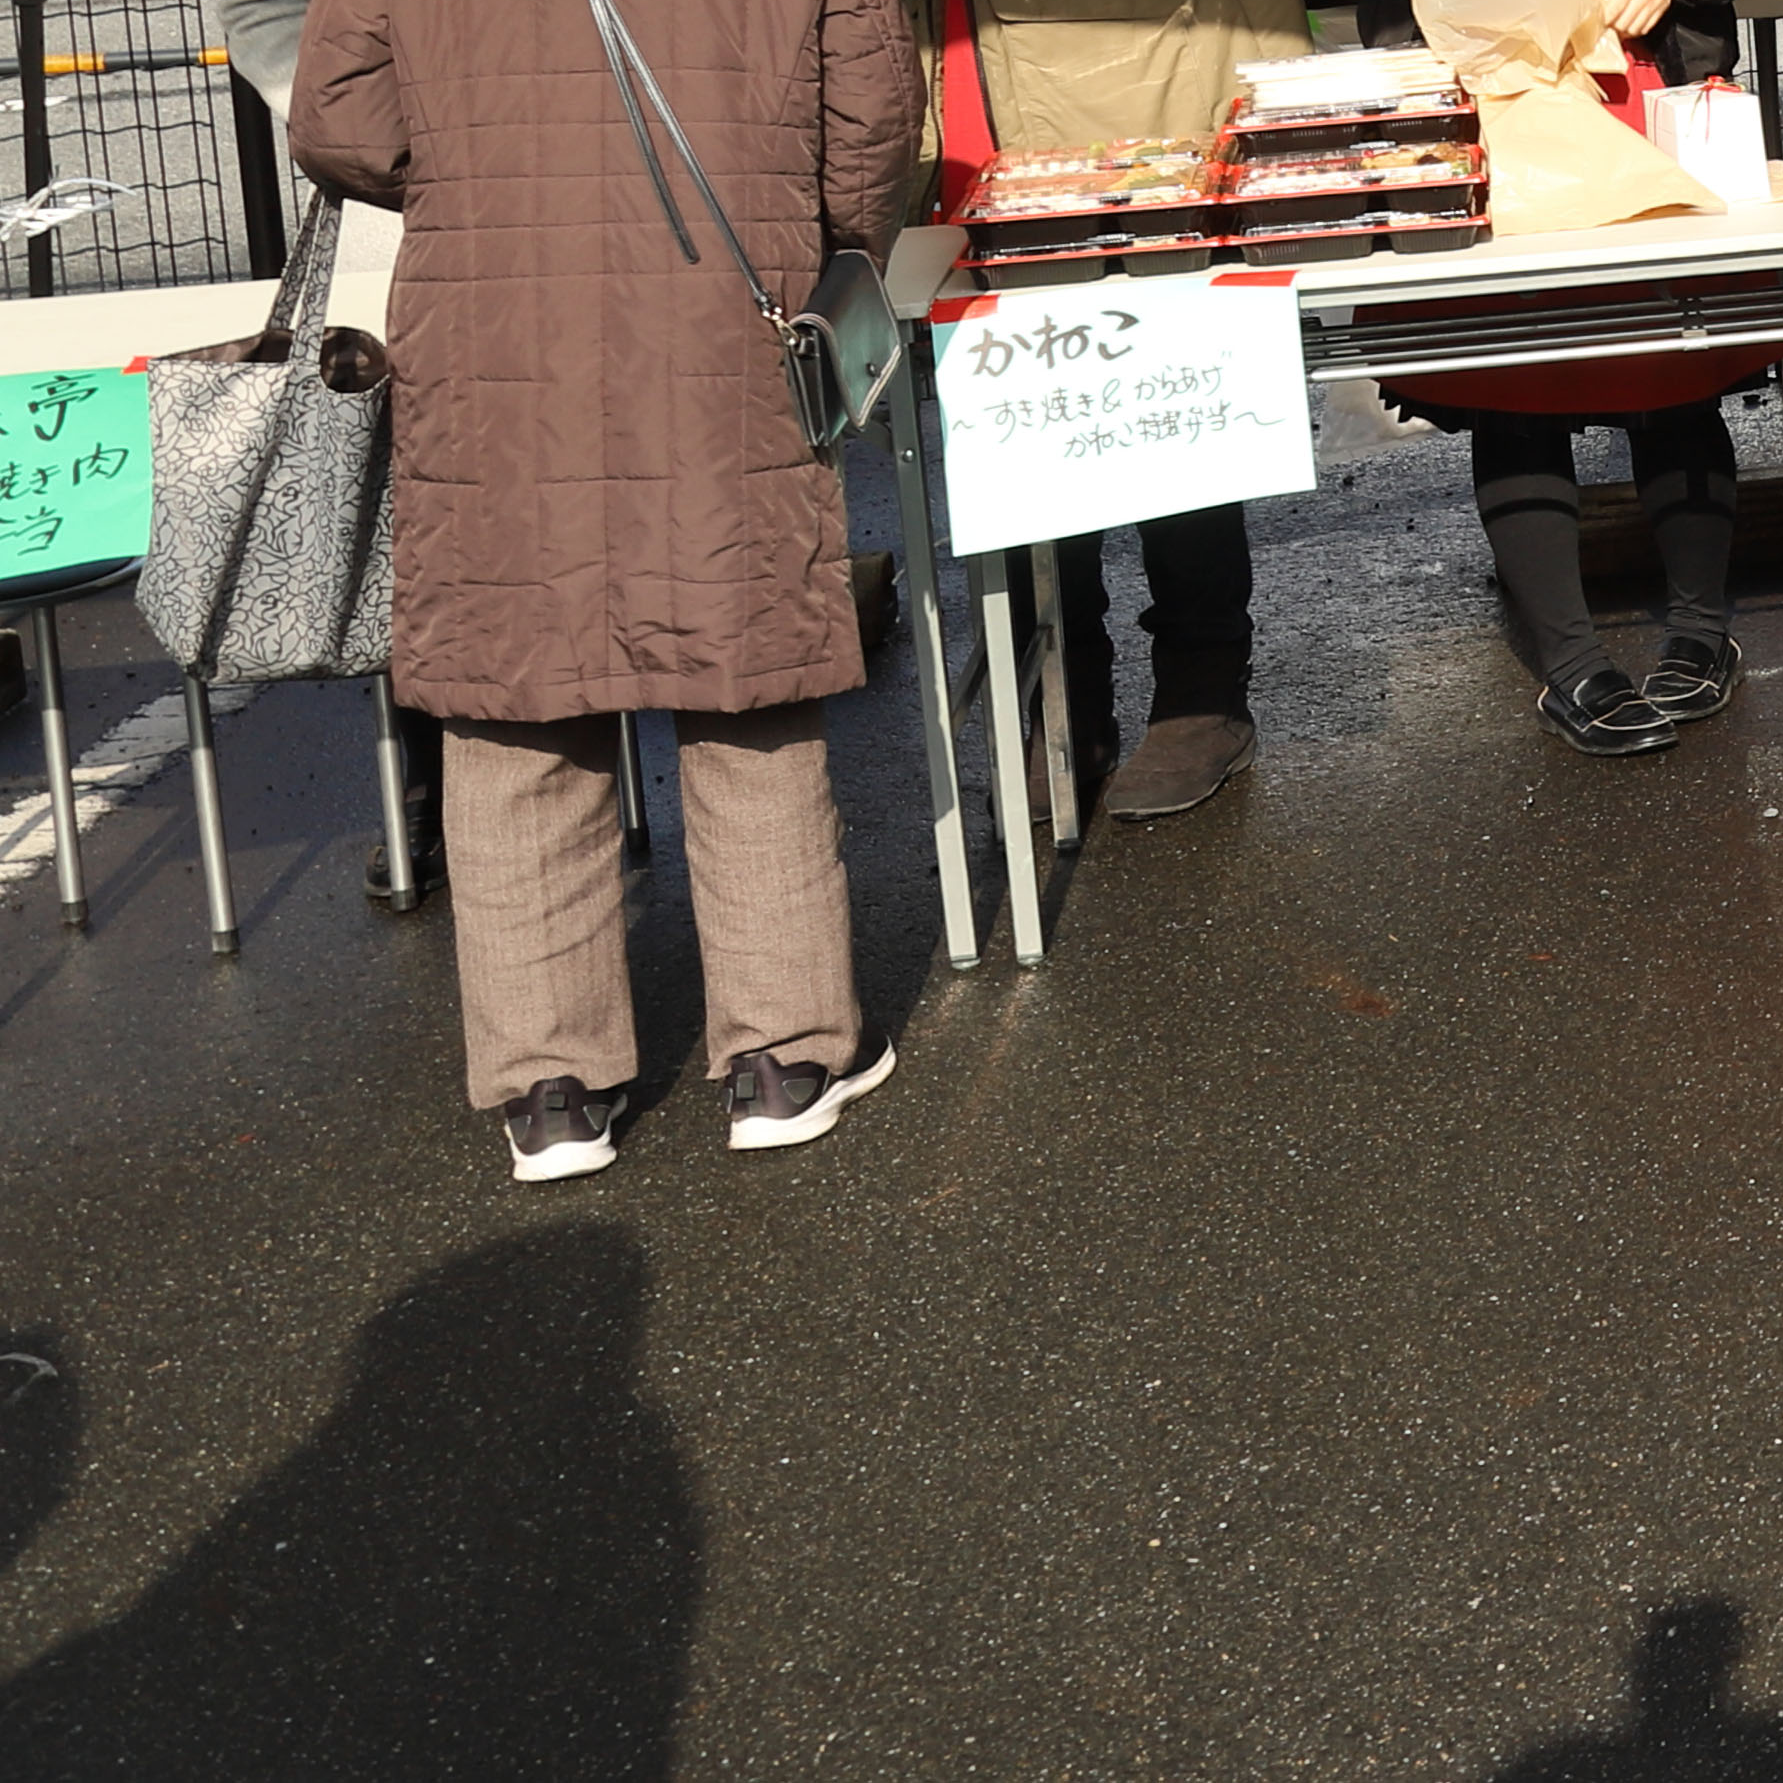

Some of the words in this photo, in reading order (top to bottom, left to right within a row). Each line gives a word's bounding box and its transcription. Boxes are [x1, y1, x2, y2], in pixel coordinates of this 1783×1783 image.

[967, 309, 1139, 377] かねこ
[0, 373, 98, 441] 亭
